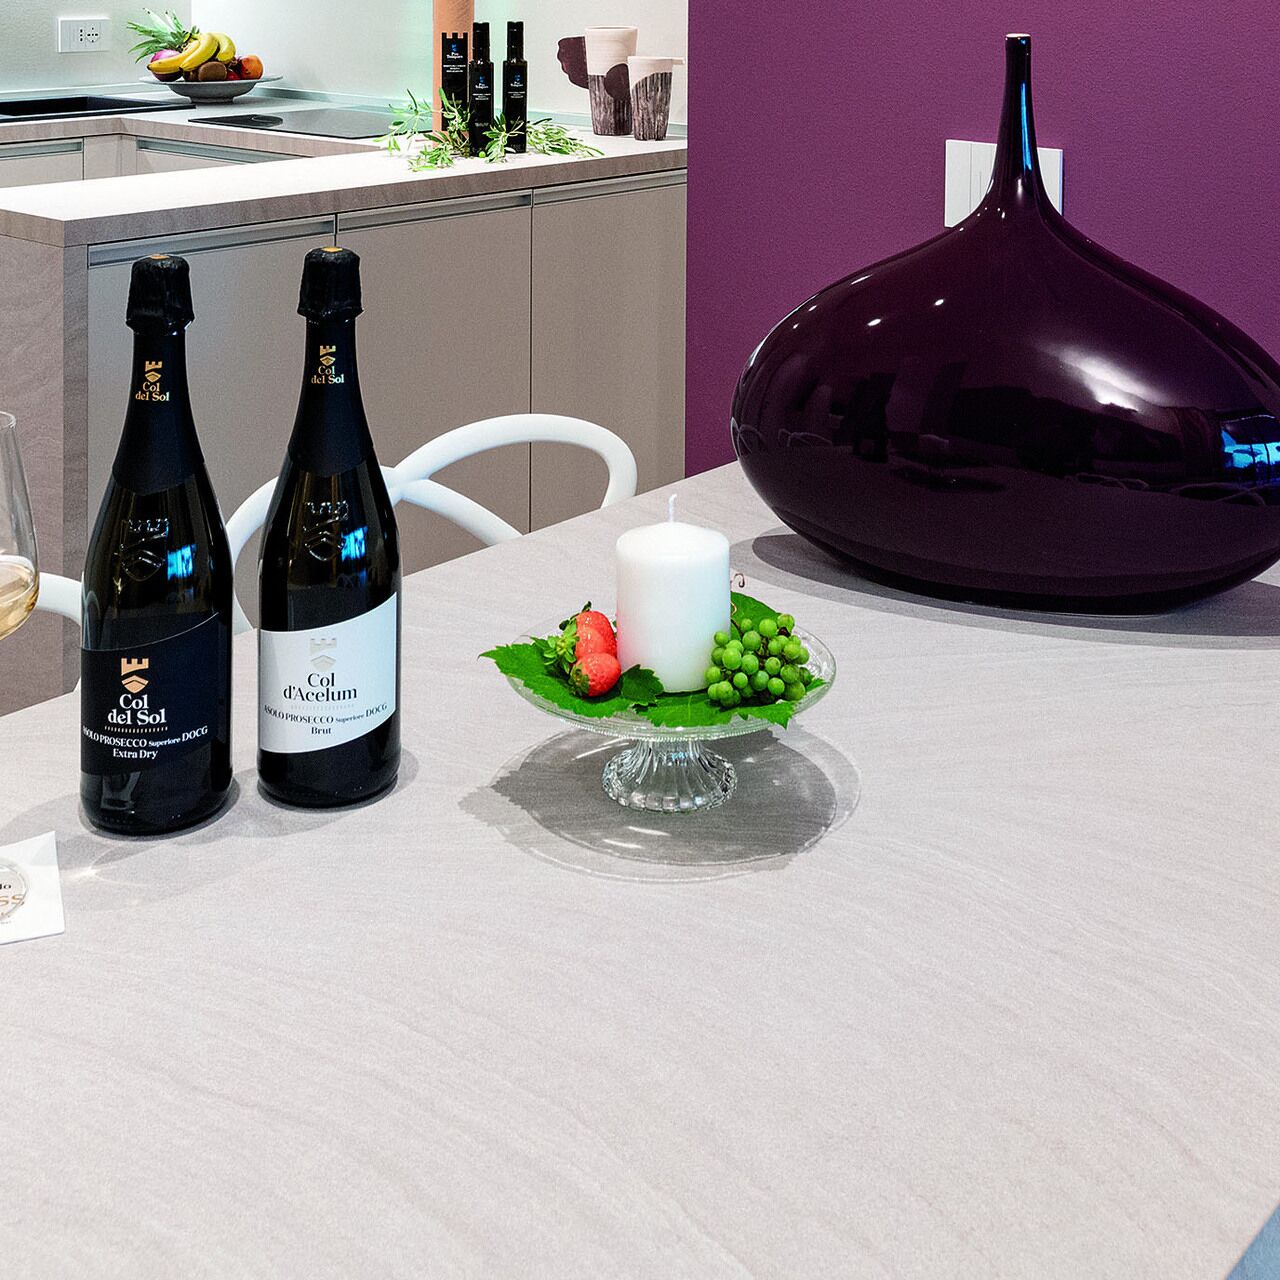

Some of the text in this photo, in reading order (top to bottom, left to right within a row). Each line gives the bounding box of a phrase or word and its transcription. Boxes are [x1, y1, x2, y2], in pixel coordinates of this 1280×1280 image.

[318, 365, 336, 376] Col
[311, 374, 345, 384] del Sol
[142, 381, 160, 392] Col
[135, 391, 170, 402] del Sol
[307, 672, 336, 688] Col
[283, 685, 358, 703] d'Acelum
[119, 693, 150, 710] Col
[107, 707, 167, 726] del Sol
[285, 712, 334, 724] PROSECCO
[365, 702, 389, 718] DOCG
[99, 734, 148, 748] PROSECCO
[148, 736, 181, 748] Superiore
[181, 725, 209, 742] DOCG
[311, 726, 332, 735] Brut
[112, 748, 159, 760] Extra Dry
